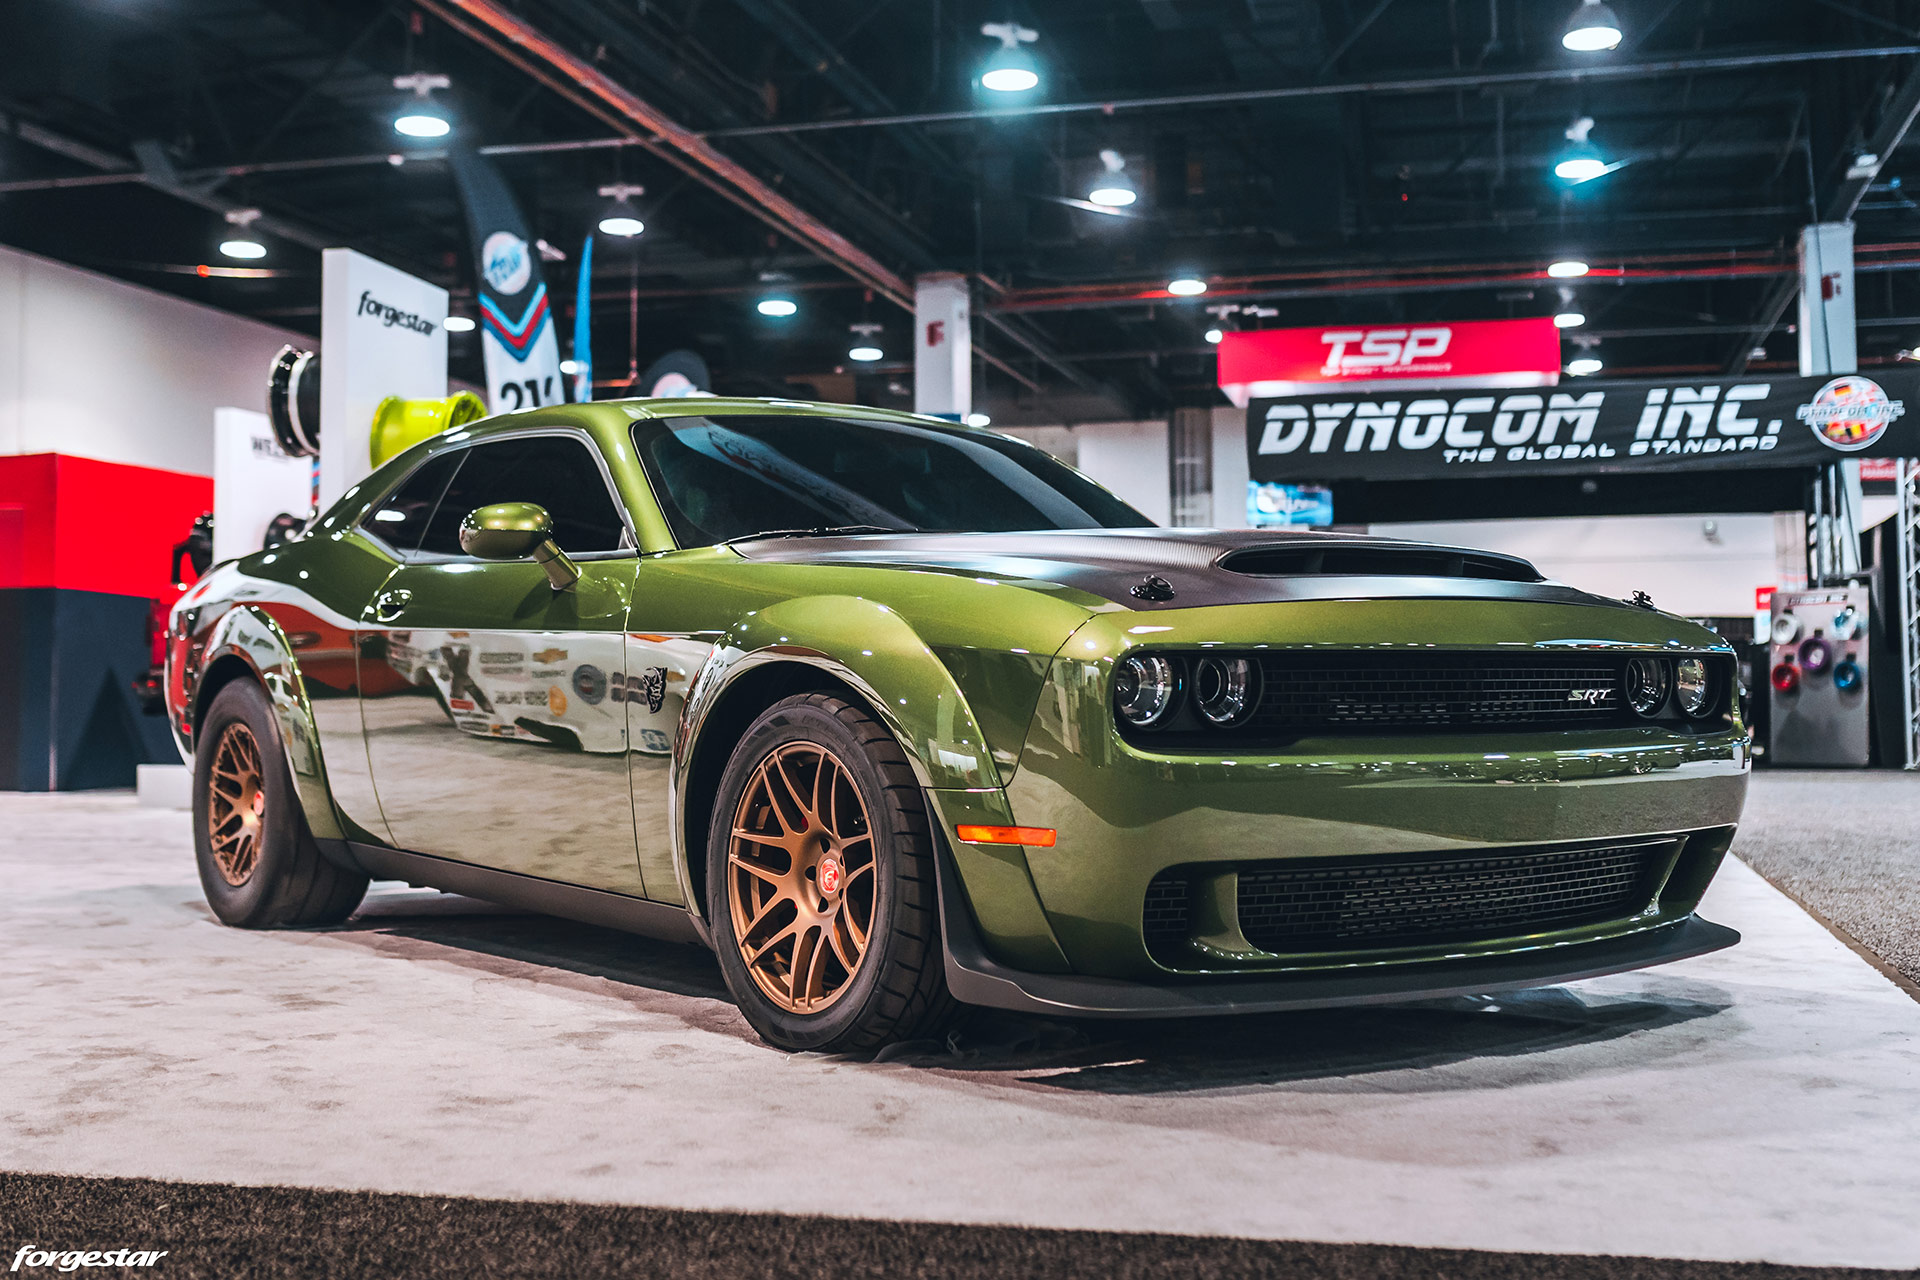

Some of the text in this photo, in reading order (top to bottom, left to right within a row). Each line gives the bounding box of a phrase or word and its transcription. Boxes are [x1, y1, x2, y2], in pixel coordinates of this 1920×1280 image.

[358, 290, 437, 336] forgestar
[1320, 327, 1452, 367] TSP
[1258, 384, 1782, 455] DYNOCOM INC.
[1443, 435, 1779, 463] THE GLOBAL STANDARD
[1567, 688, 1612, 704] SRT
